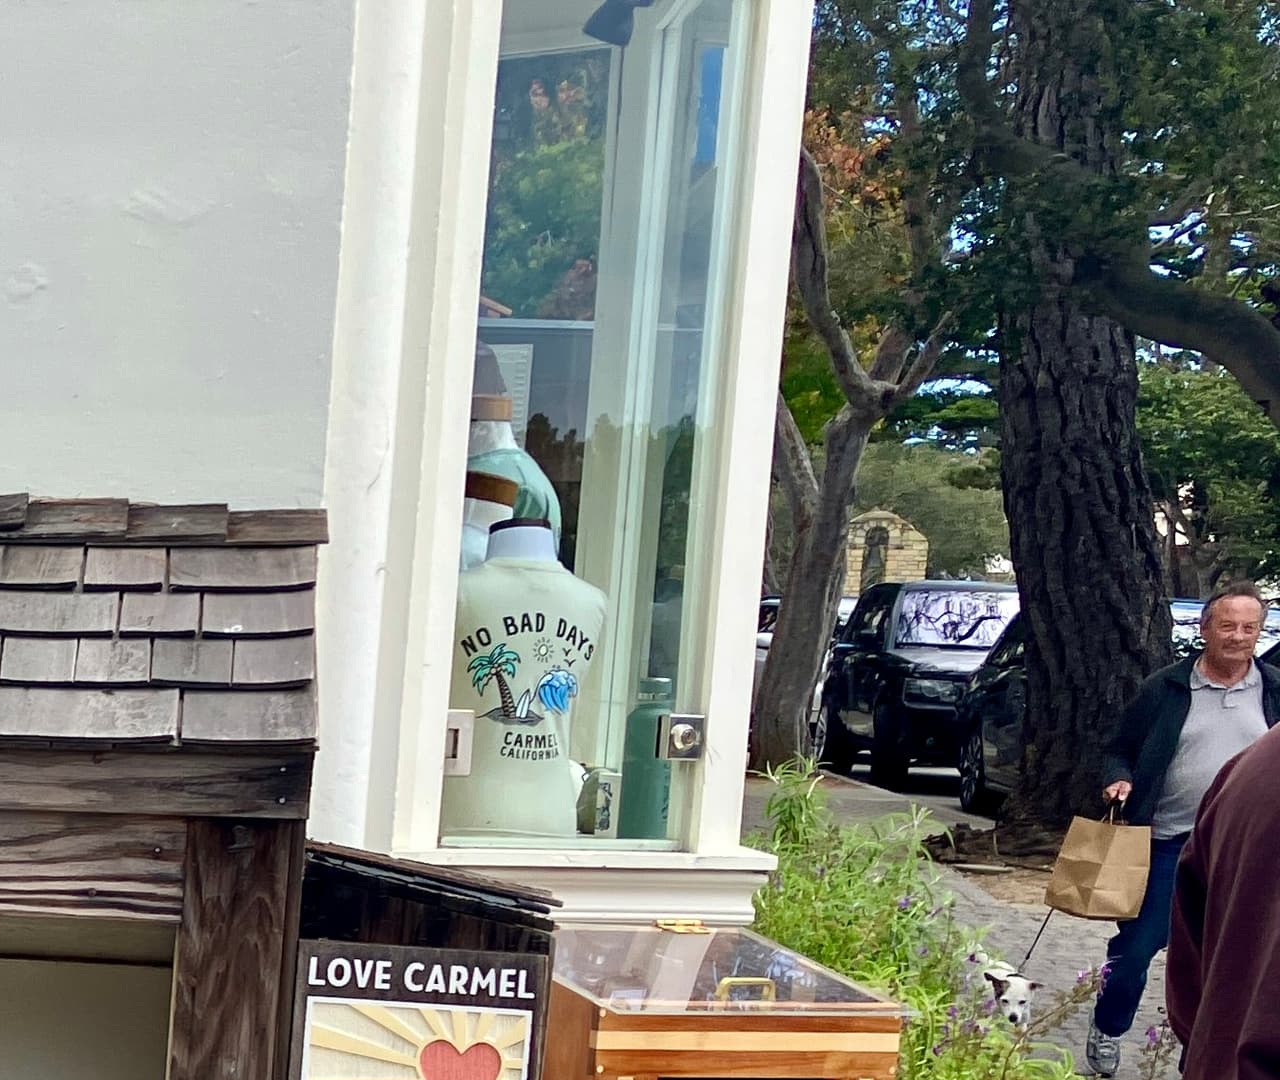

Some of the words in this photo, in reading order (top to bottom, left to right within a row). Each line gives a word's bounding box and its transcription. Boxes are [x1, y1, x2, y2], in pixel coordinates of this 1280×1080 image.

[460, 627, 492, 657] NO
[502, 612, 546, 637] BAD
[556, 617, 595, 661] DAYS
[499, 745, 560, 761] CALIFORNIA
[503, 731, 559, 749] CARMEL
[307, 956, 392, 990] LOVE
[403, 961, 536, 1000] CARMEL
